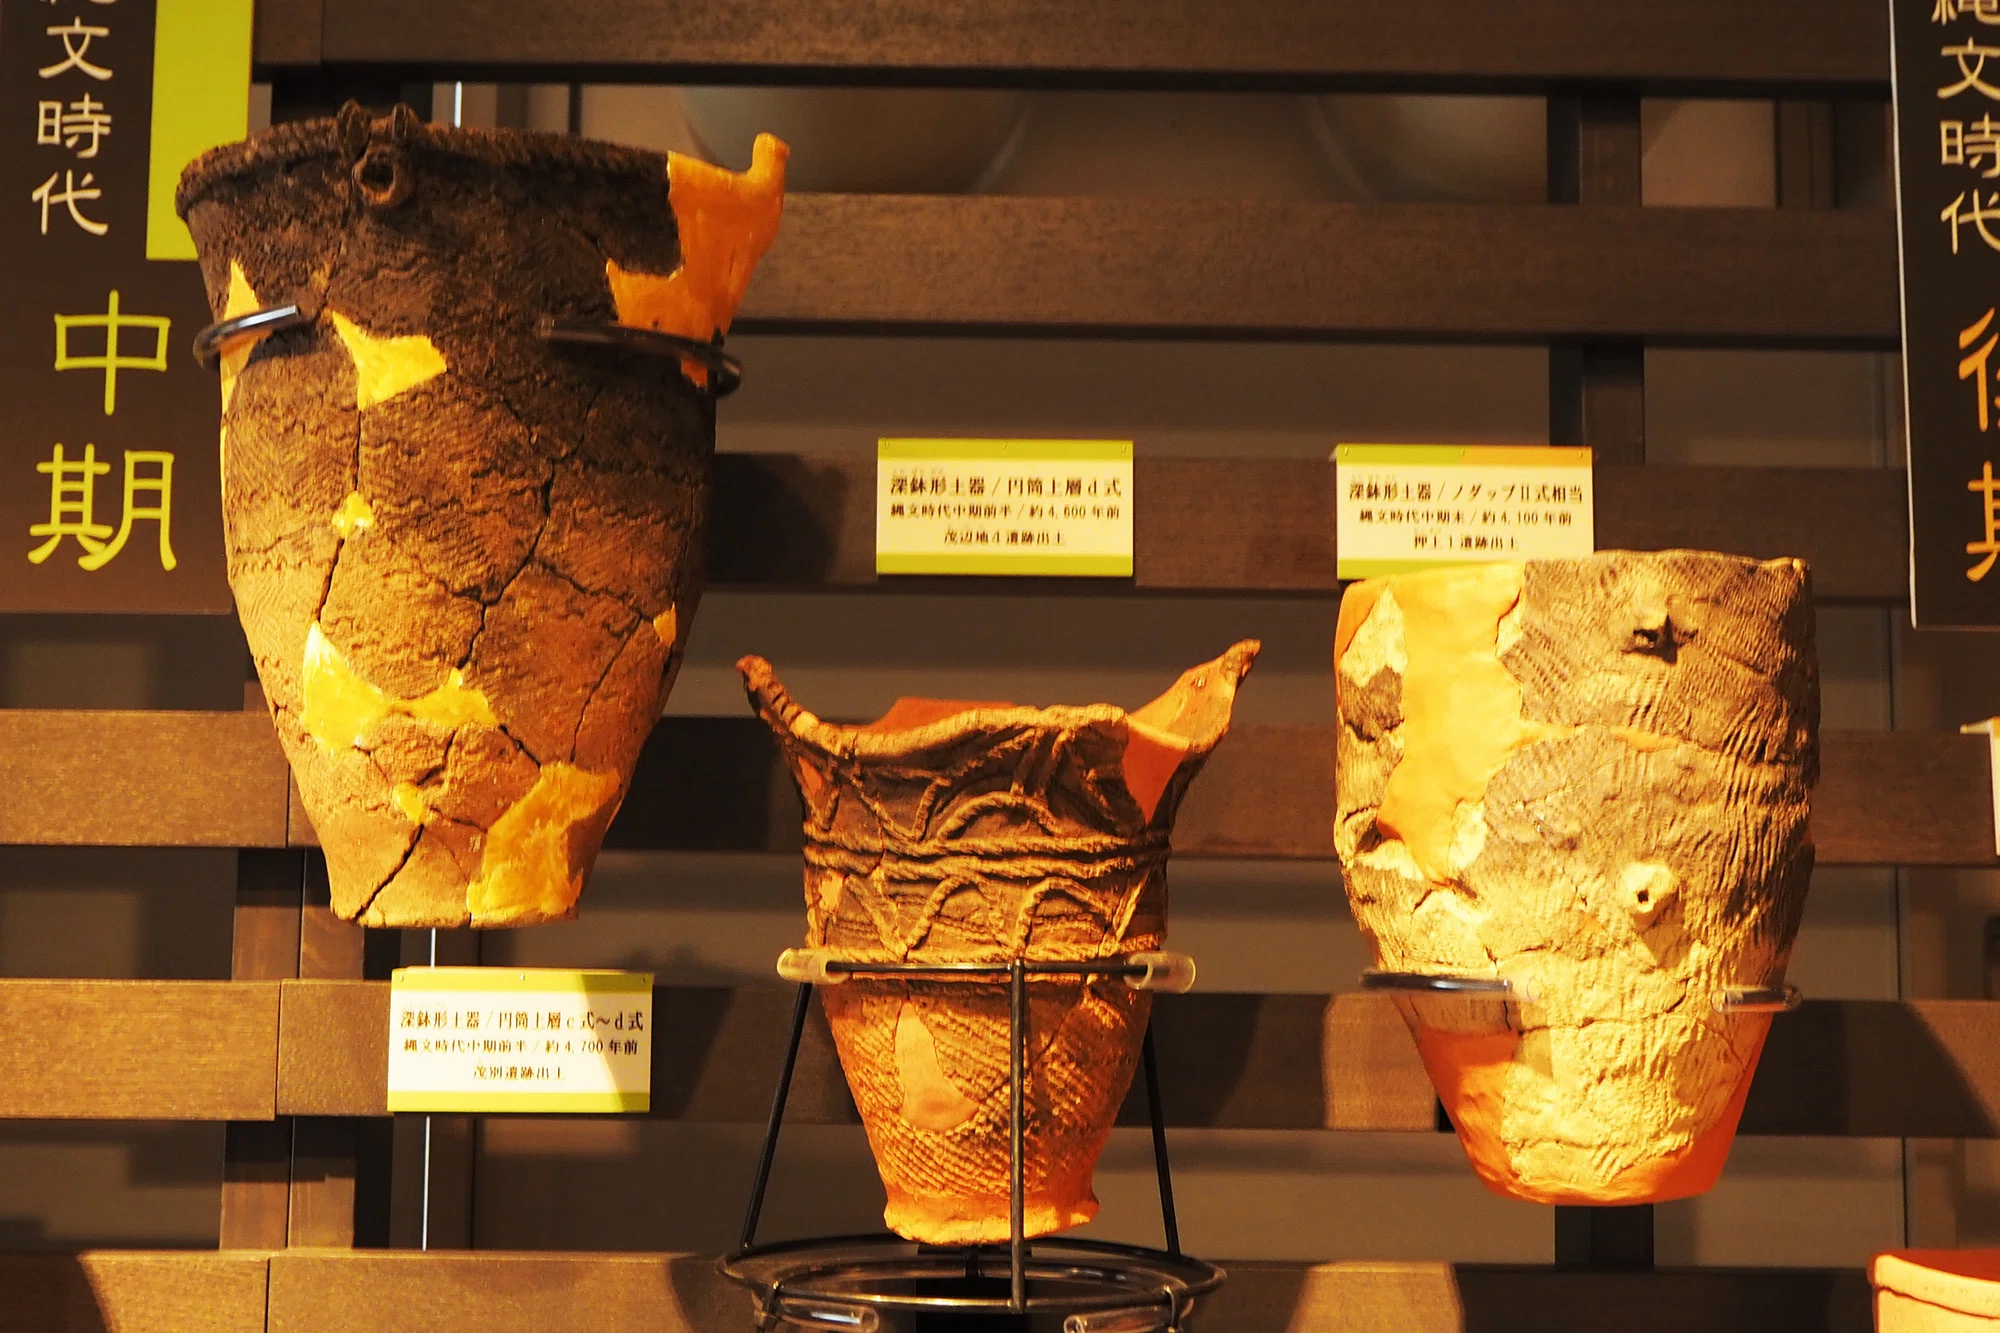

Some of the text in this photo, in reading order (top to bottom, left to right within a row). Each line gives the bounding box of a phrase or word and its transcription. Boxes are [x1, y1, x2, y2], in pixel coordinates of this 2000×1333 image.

[32, 0, 118, 236] 文時代
[28, 289, 176, 571] 中期
